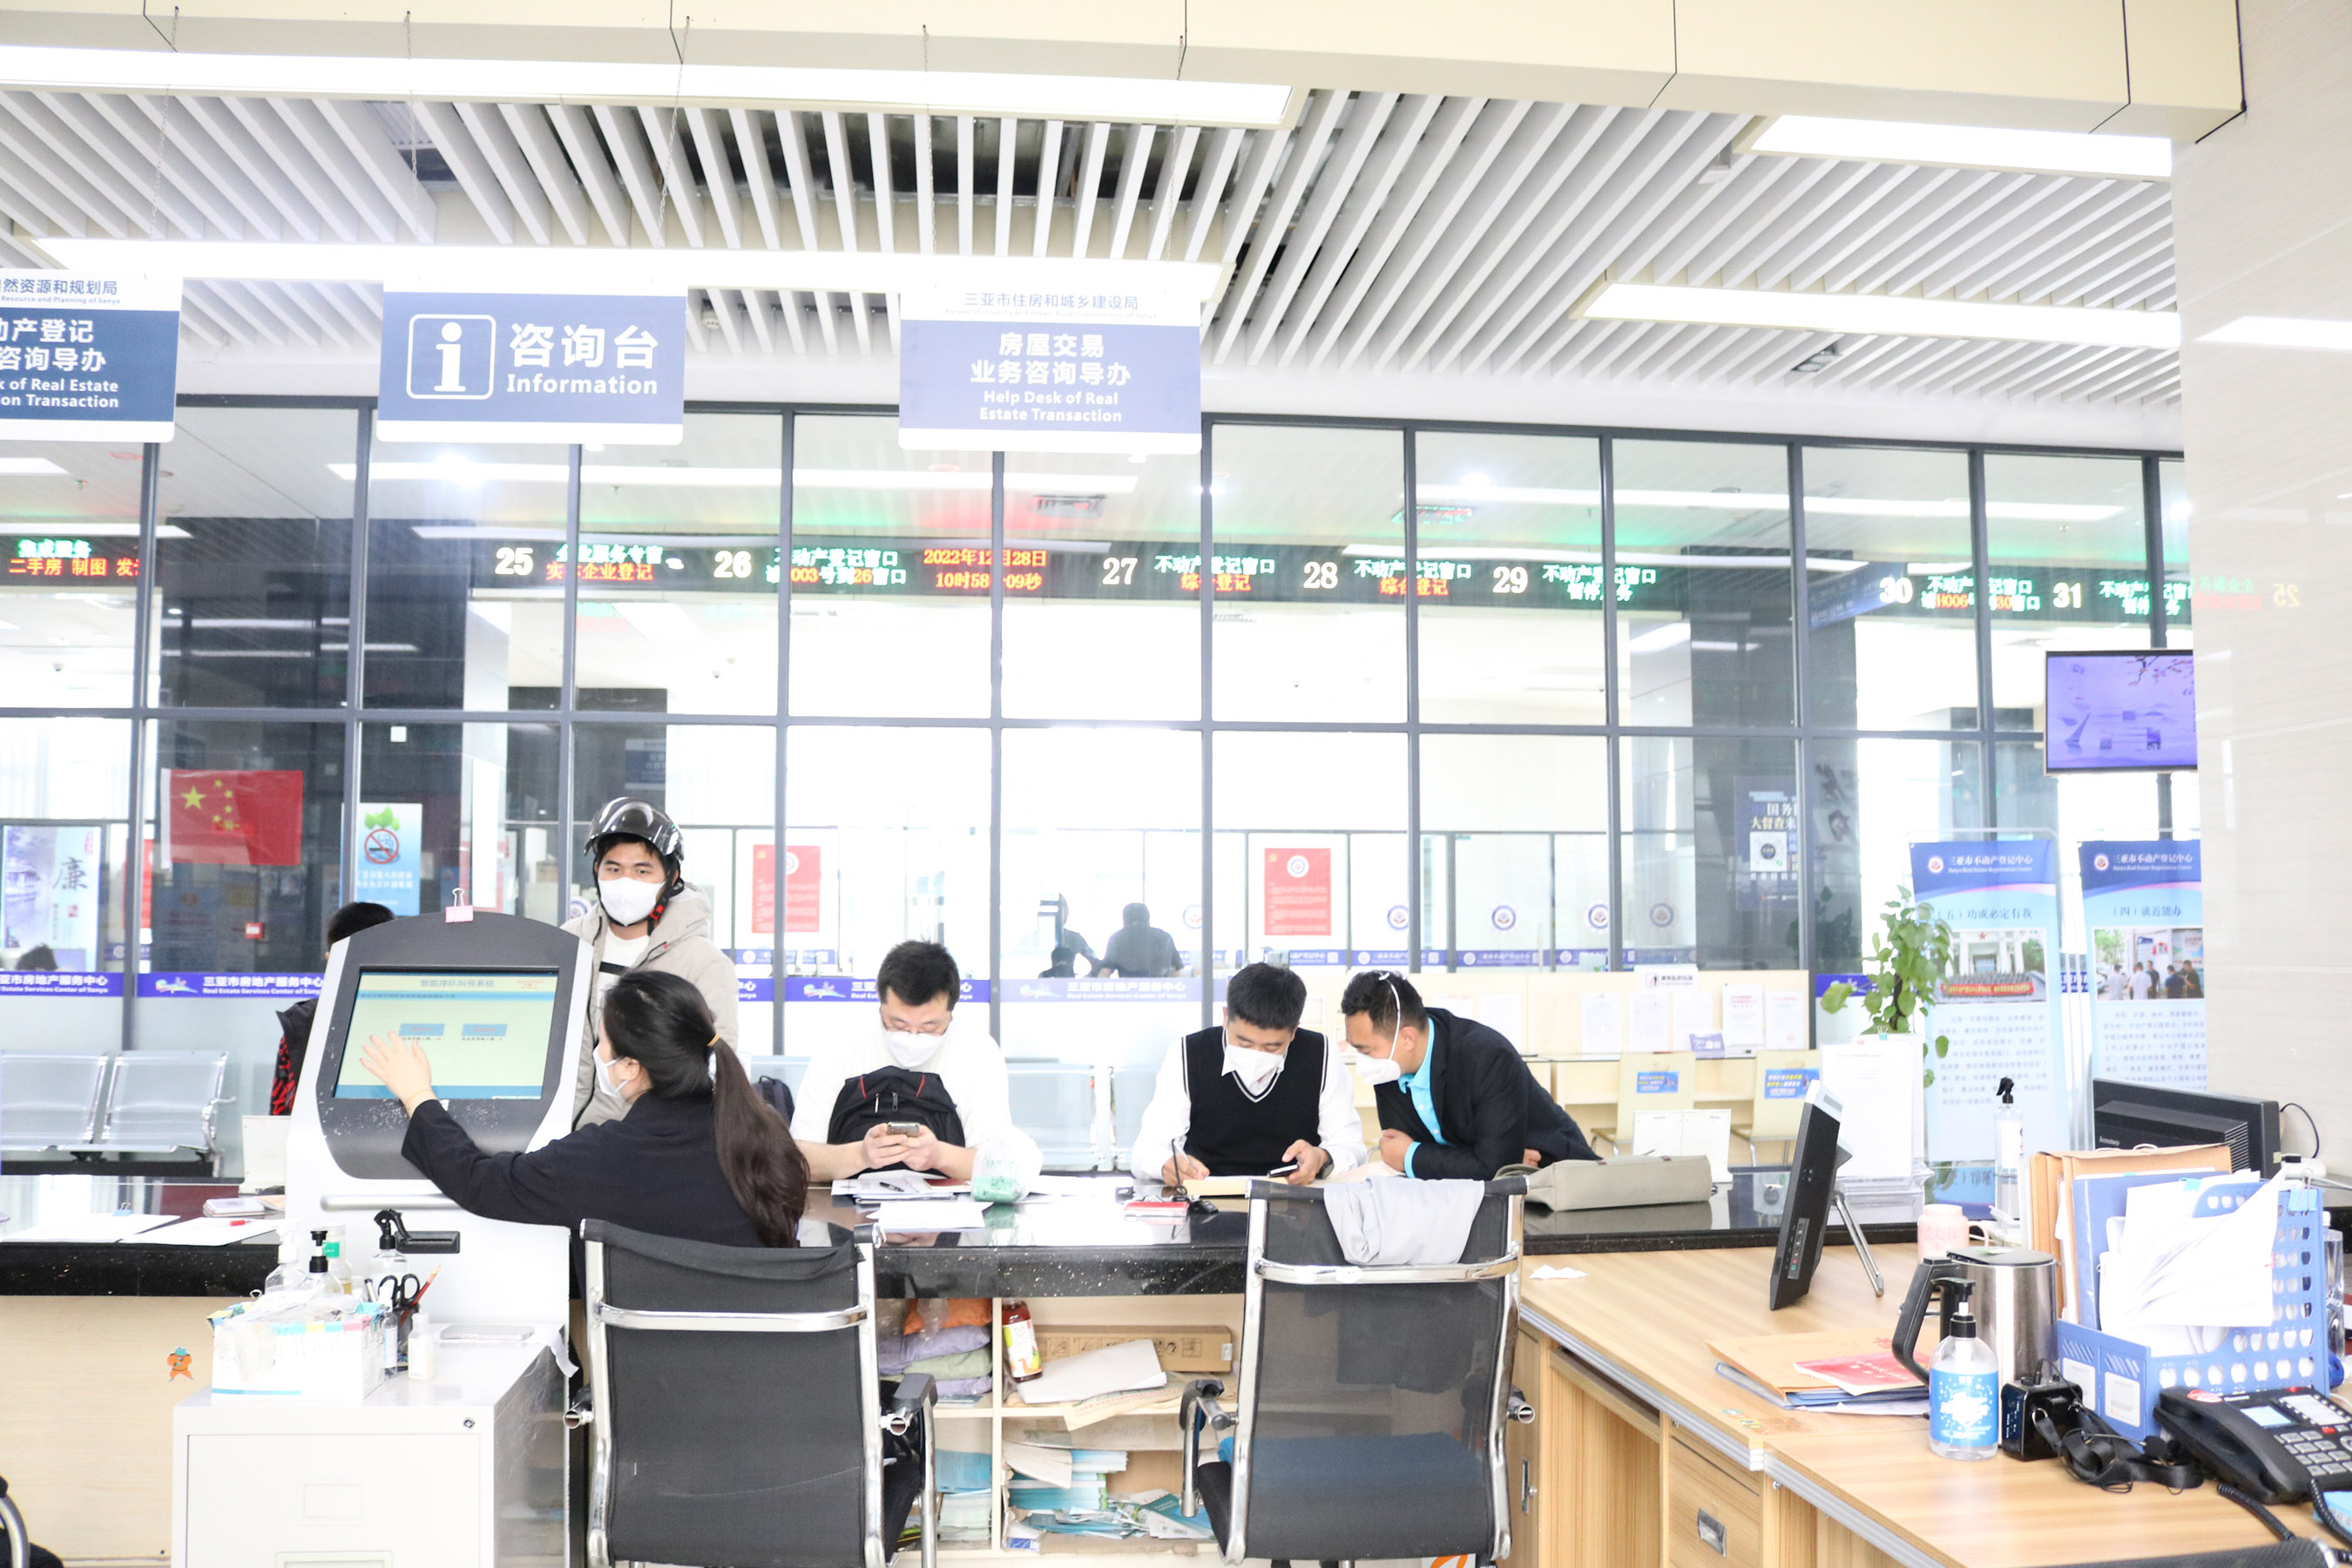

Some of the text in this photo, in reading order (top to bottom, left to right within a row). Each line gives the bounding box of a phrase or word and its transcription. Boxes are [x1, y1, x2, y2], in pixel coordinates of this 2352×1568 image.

[0, 278, 118, 295] 然资源和规划局
[53, 296, 86, 305] Planning
[98, 297, 120, 306] Sanya
[963, 292, 1139, 310] 三亚市住房和城乡建设局
[509, 323, 659, 368] 咨询台
[998, 332, 1104, 358] 房屋交易
[970, 360, 1132, 386] 业务咨询导办
[10, 377, 27, 390] of
[31, 378, 64, 391] Real
[70, 379, 118, 392] Estate
[507, 373, 658, 395] Information
[26, 394, 119, 408] Transaction
[983, 390, 1119, 407] Help Desk of Real
[980, 407, 1123, 422] Estate Transaction
[9, 558, 63, 576] 二手房
[71, 558, 107, 576] 制图
[495, 547, 534, 576] 25
[546, 561, 654, 581] 实企业登记
[713, 551, 752, 578] 26
[1102, 557, 1138, 585] 27
[936, 571, 1043, 591] 10时5809秒
[1180, 572, 1252, 591] 综登记
[1302, 562, 1338, 589] 28
[1492, 566, 1528, 593] 29
[1927, 575, 2032, 595] 不动产记窗口
[1567, 582, 1632, 601] 暂停务
[1879, 577, 1913, 604] 30
[2053, 582, 2082, 608] 31
[2099, 580, 2193, 600] 不动产记窗
[2122, 595, 2180, 616] 暂停务
[1950, 855, 2033, 866] 三亚市不动产登记中心
[2114, 854, 2193, 865] 三亚市不动产登记中心
[52, 856, 87, 890] 廉
[1067, 982, 1186, 992] 三亚市房地产服务中心
[2099, 1135, 2120, 1146] lenovo
